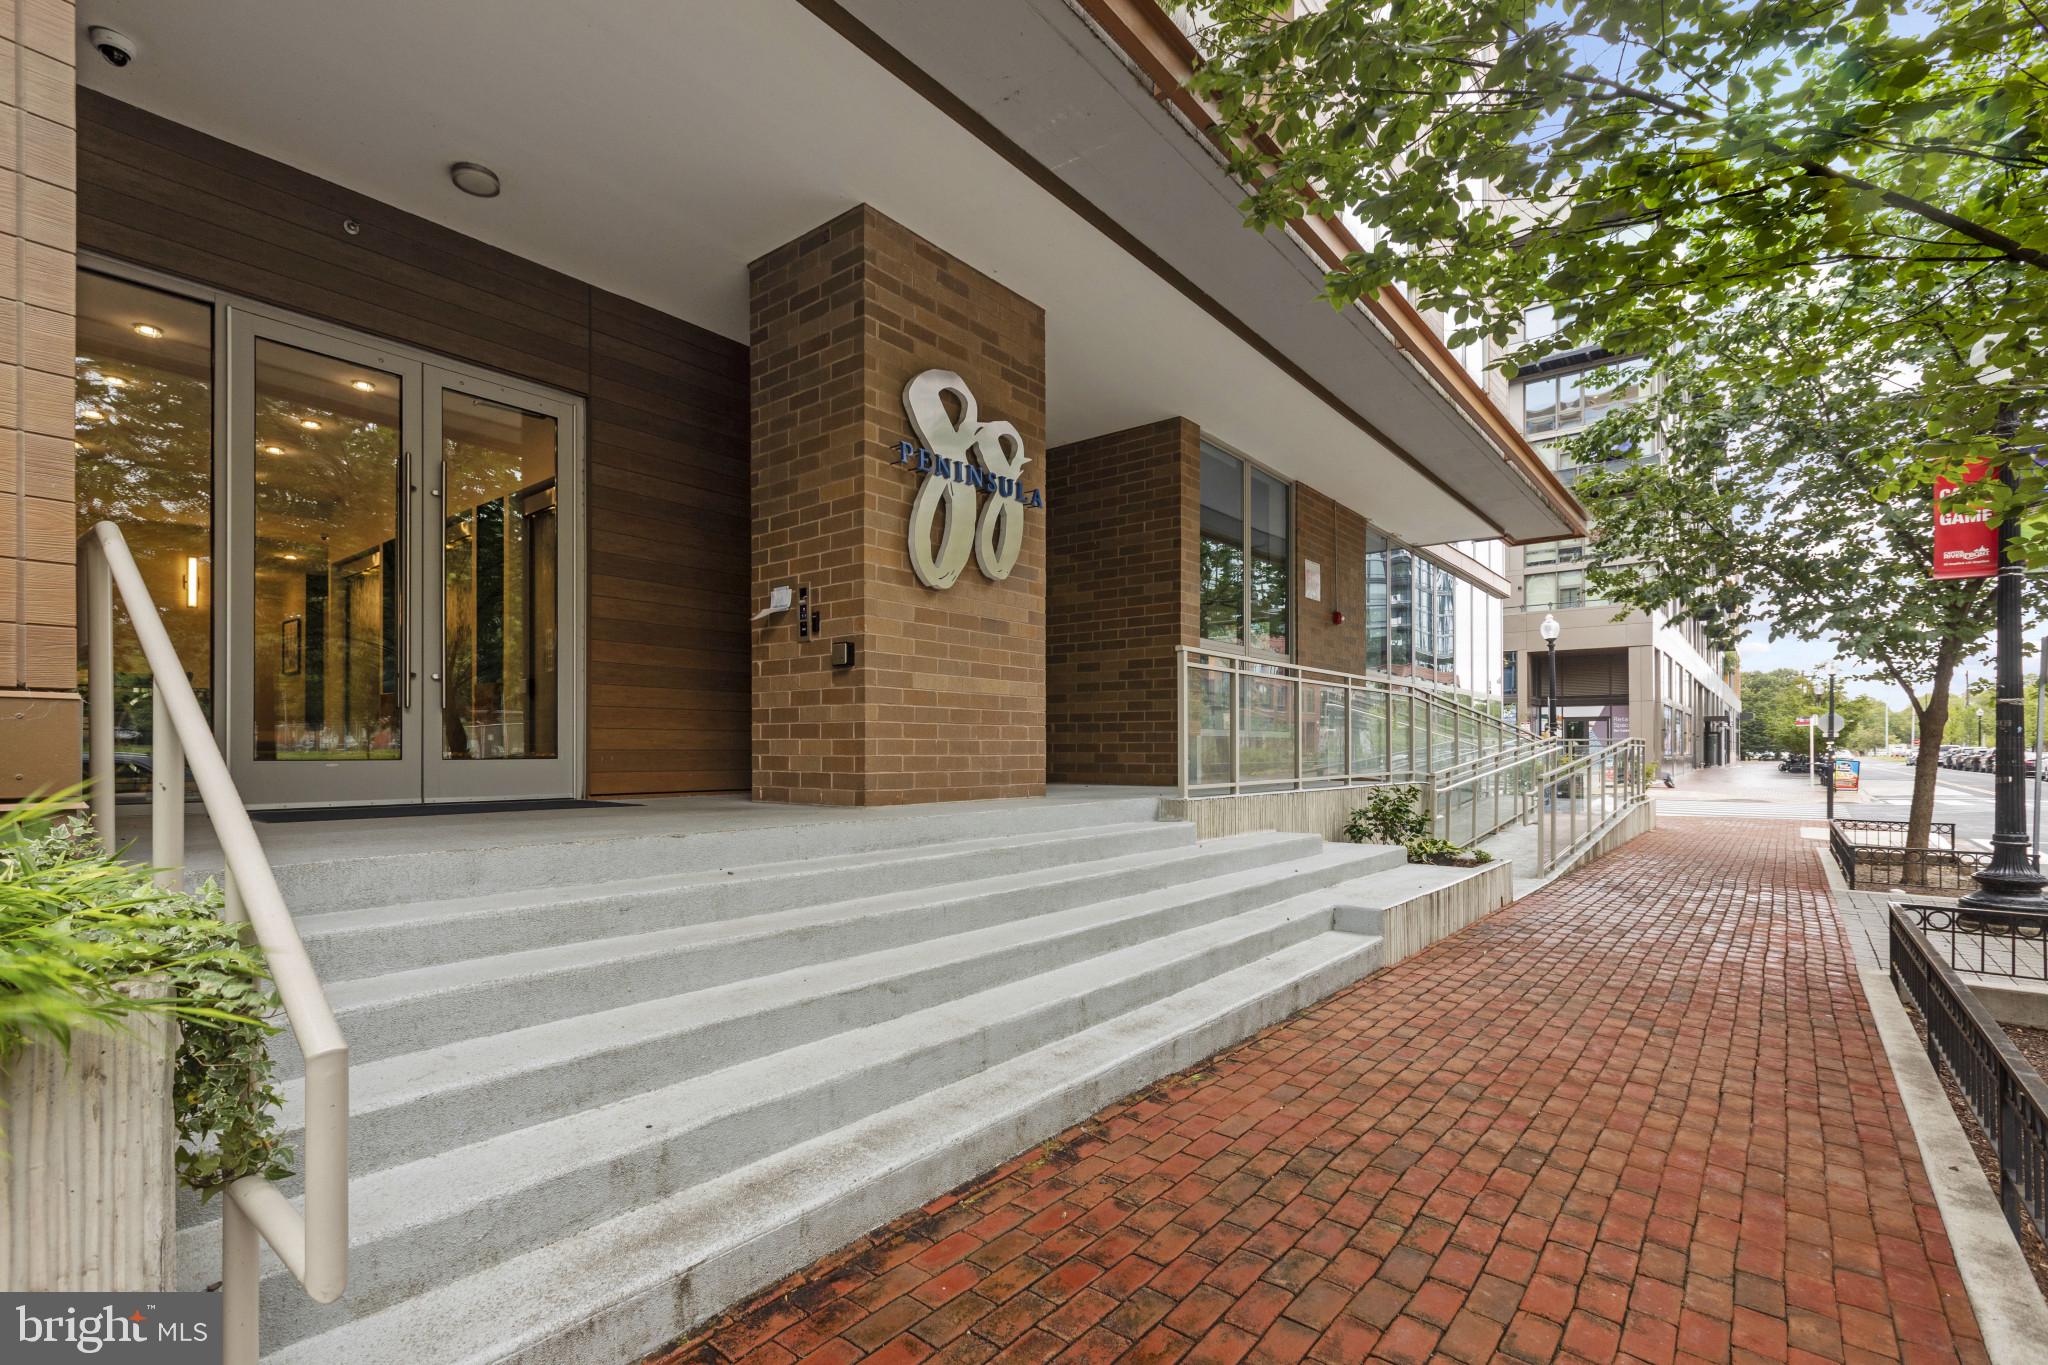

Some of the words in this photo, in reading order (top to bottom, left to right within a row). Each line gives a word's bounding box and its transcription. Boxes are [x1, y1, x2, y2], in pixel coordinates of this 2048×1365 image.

[899, 441, 1043, 509] PENINSULA
[903, 368, 1032, 590] 88
[1940, 509, 1993, 526] GAME
